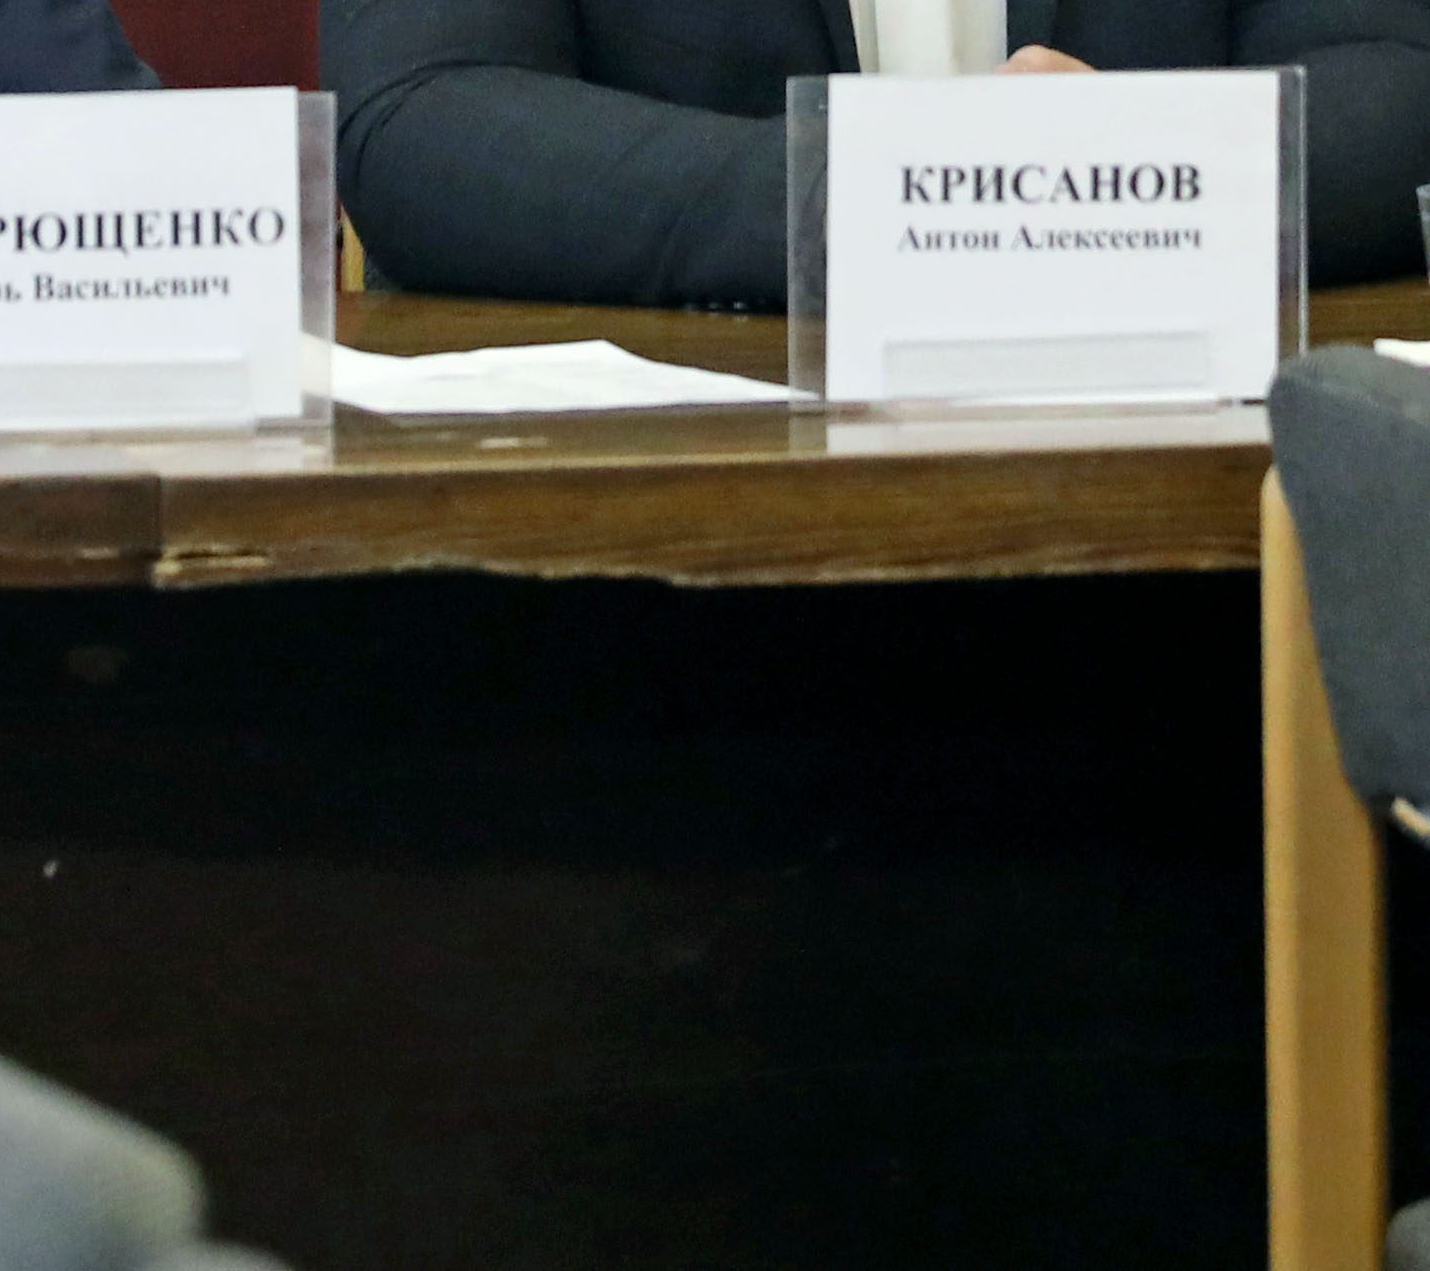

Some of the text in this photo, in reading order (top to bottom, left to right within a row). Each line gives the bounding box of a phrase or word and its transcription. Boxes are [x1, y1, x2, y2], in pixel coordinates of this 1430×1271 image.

[900, 163, 1203, 205] КРИСАНОВ
[898, 224, 1203, 253] Антон Алексеевич
[31, 272, 231, 303] Васильевич
